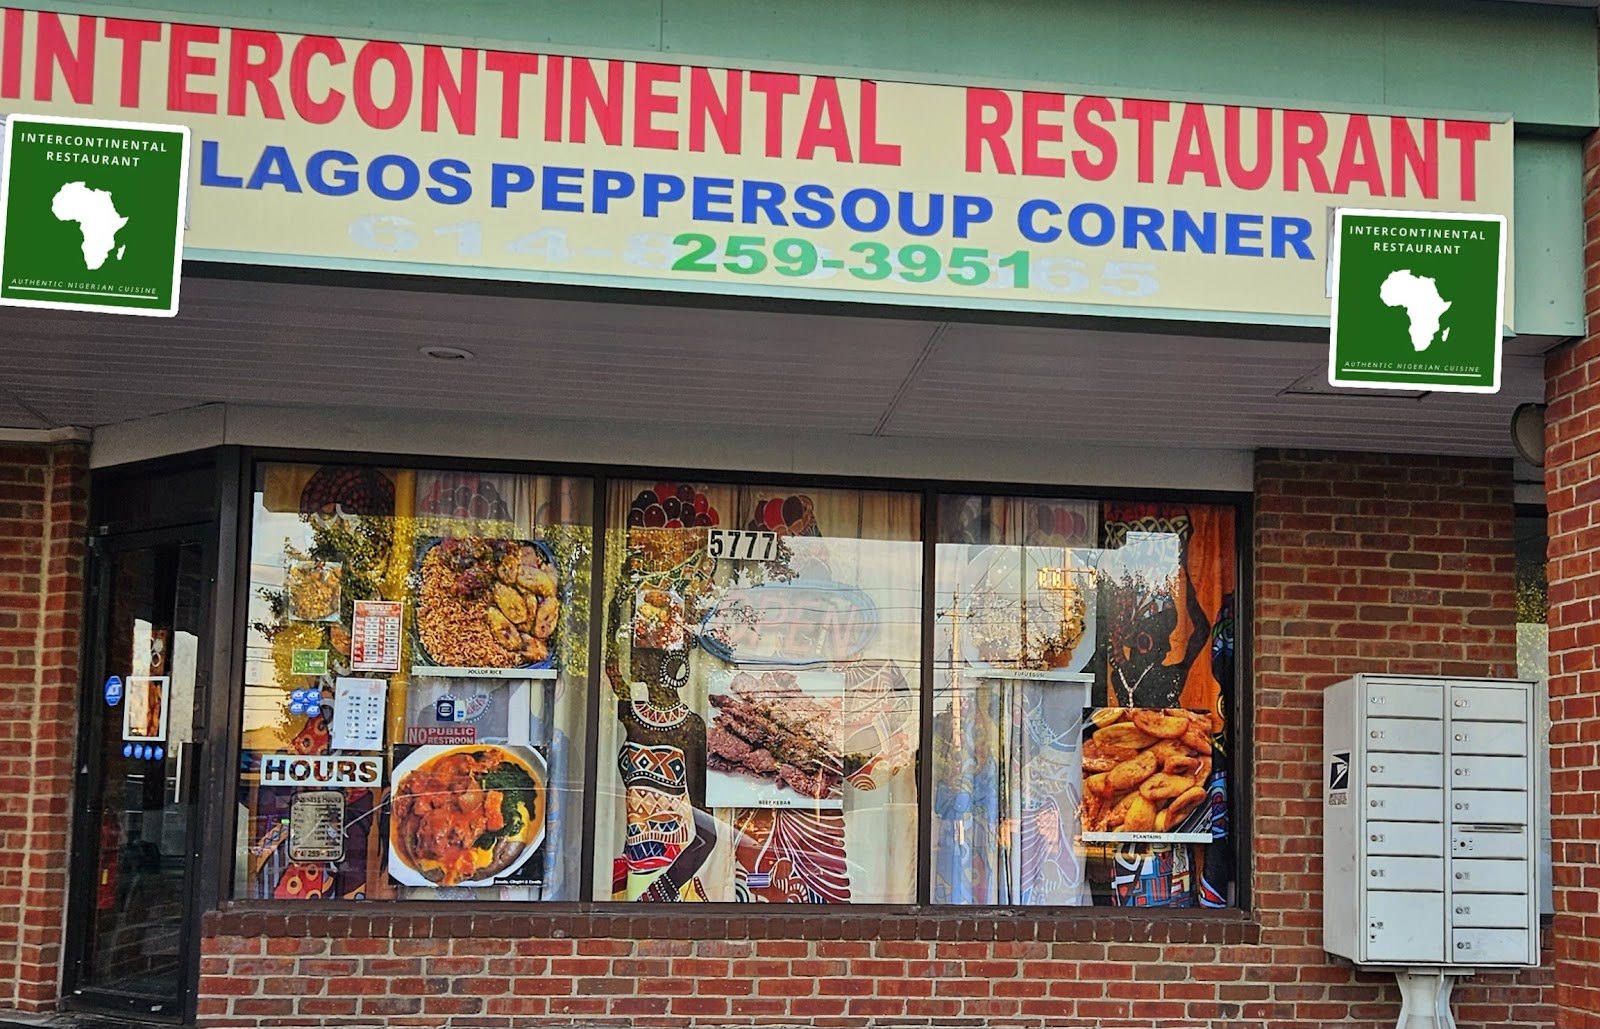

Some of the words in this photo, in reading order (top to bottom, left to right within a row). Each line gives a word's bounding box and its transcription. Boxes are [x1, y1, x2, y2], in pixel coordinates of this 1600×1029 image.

[1, 9, 901, 166] INTERCONTINENTAL
[965, 88, 1491, 202] RESTAURANT
[21, 132, 167, 152] INTERCONTINENTAL
[46, 151, 140, 167] RESTAURANT
[202, 142, 471, 204] LAGOS
[491, 163, 993, 238] PEPPERSOUP
[1017, 199, 1314, 260] CORNER
[1349, 225, 1486, 240] INTERCONTINENTAL
[1373, 242, 1461, 255] RESTAURANT
[671, 233, 1029, 288] 259-3951
[11, 278, 63, 288] AUTHENTIC
[67, 282, 114, 292] NIGERIAN
[118, 285, 156, 295] CUISINE
[1344, 361, 1393, 369] AUTHENTIC
[1396, 363, 1440, 371] NIGERIAN
[1444, 365, 1480, 373] CUISINE
[710, 531, 775, 559] 5777
[409, 728, 427, 744] NO
[429, 728, 474, 736] PUBLIC
[428, 736, 474, 744] RESTROOM
[265, 759, 378, 783] HOURS
